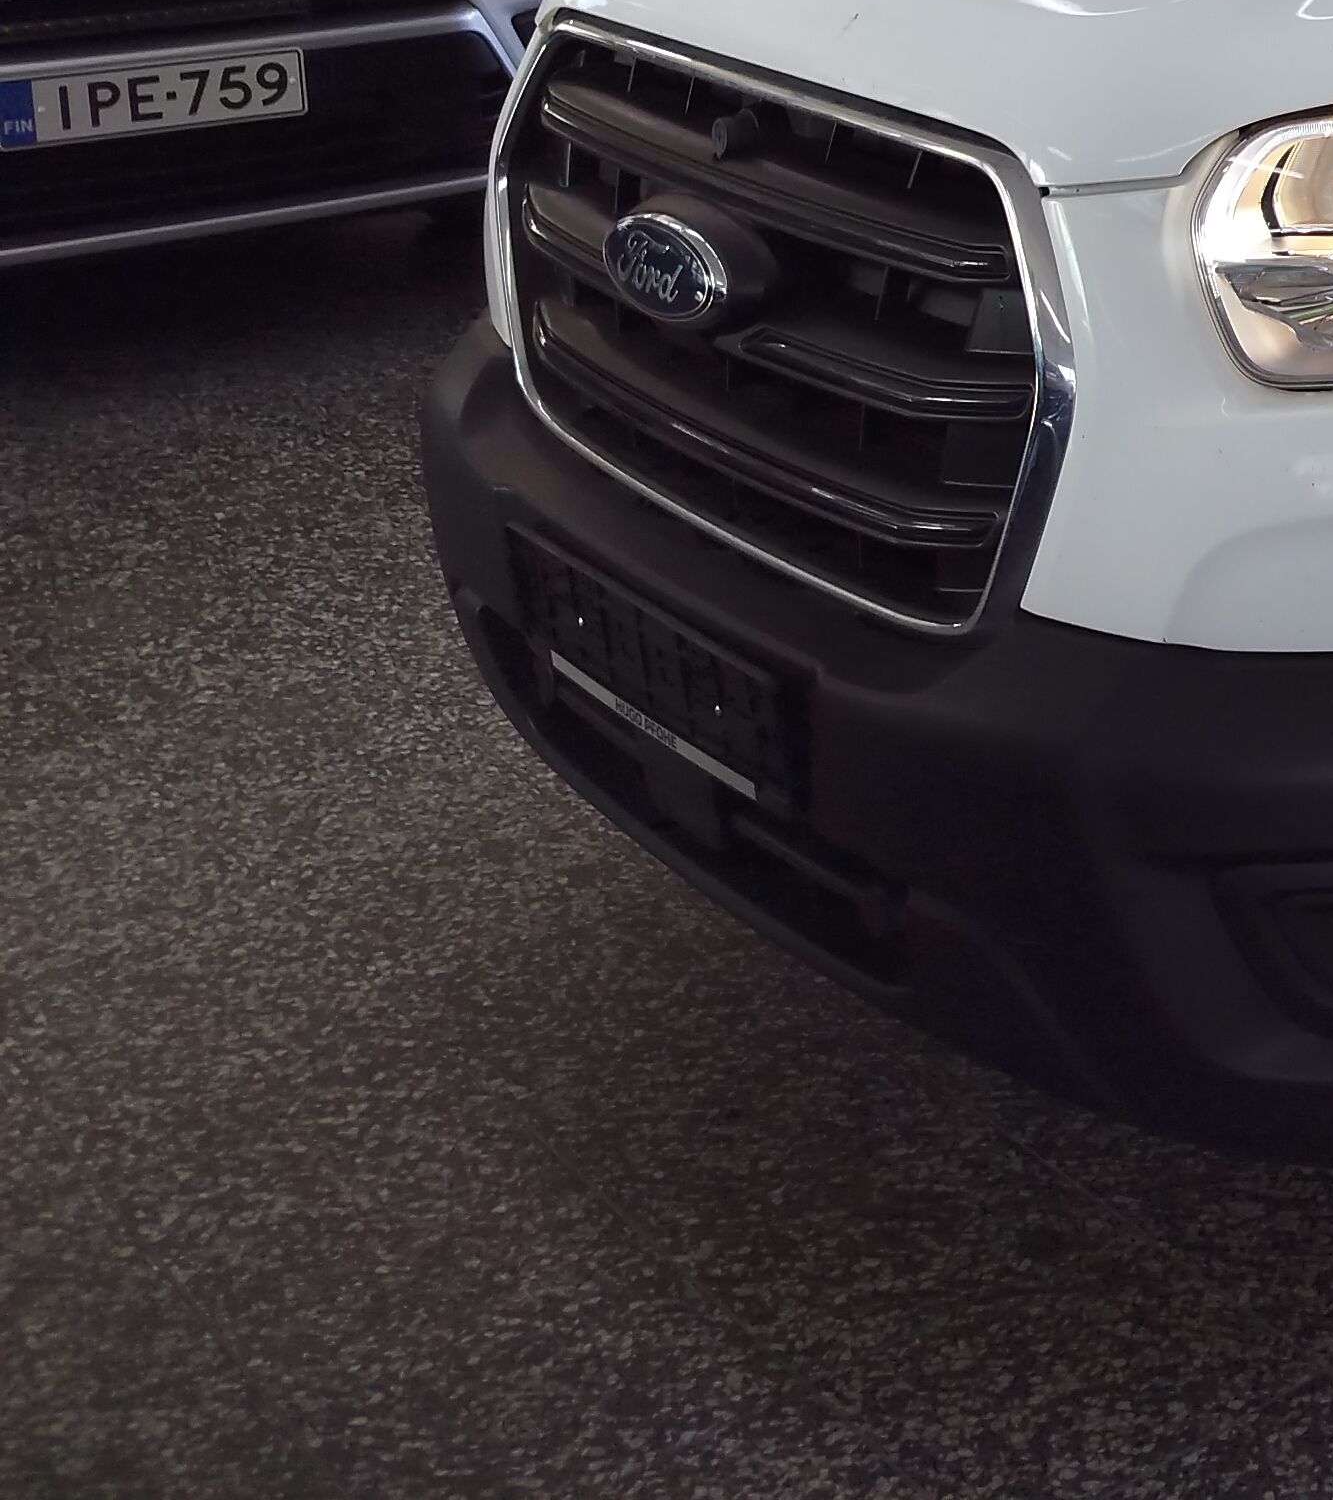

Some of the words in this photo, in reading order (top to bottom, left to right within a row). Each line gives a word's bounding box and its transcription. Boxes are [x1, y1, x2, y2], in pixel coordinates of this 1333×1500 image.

[4, 118, 34, 135] FIN
[58, 62, 288, 130] IPE-759
[616, 230, 684, 304] Ford
[614, 698, 643, 726] HUGO
